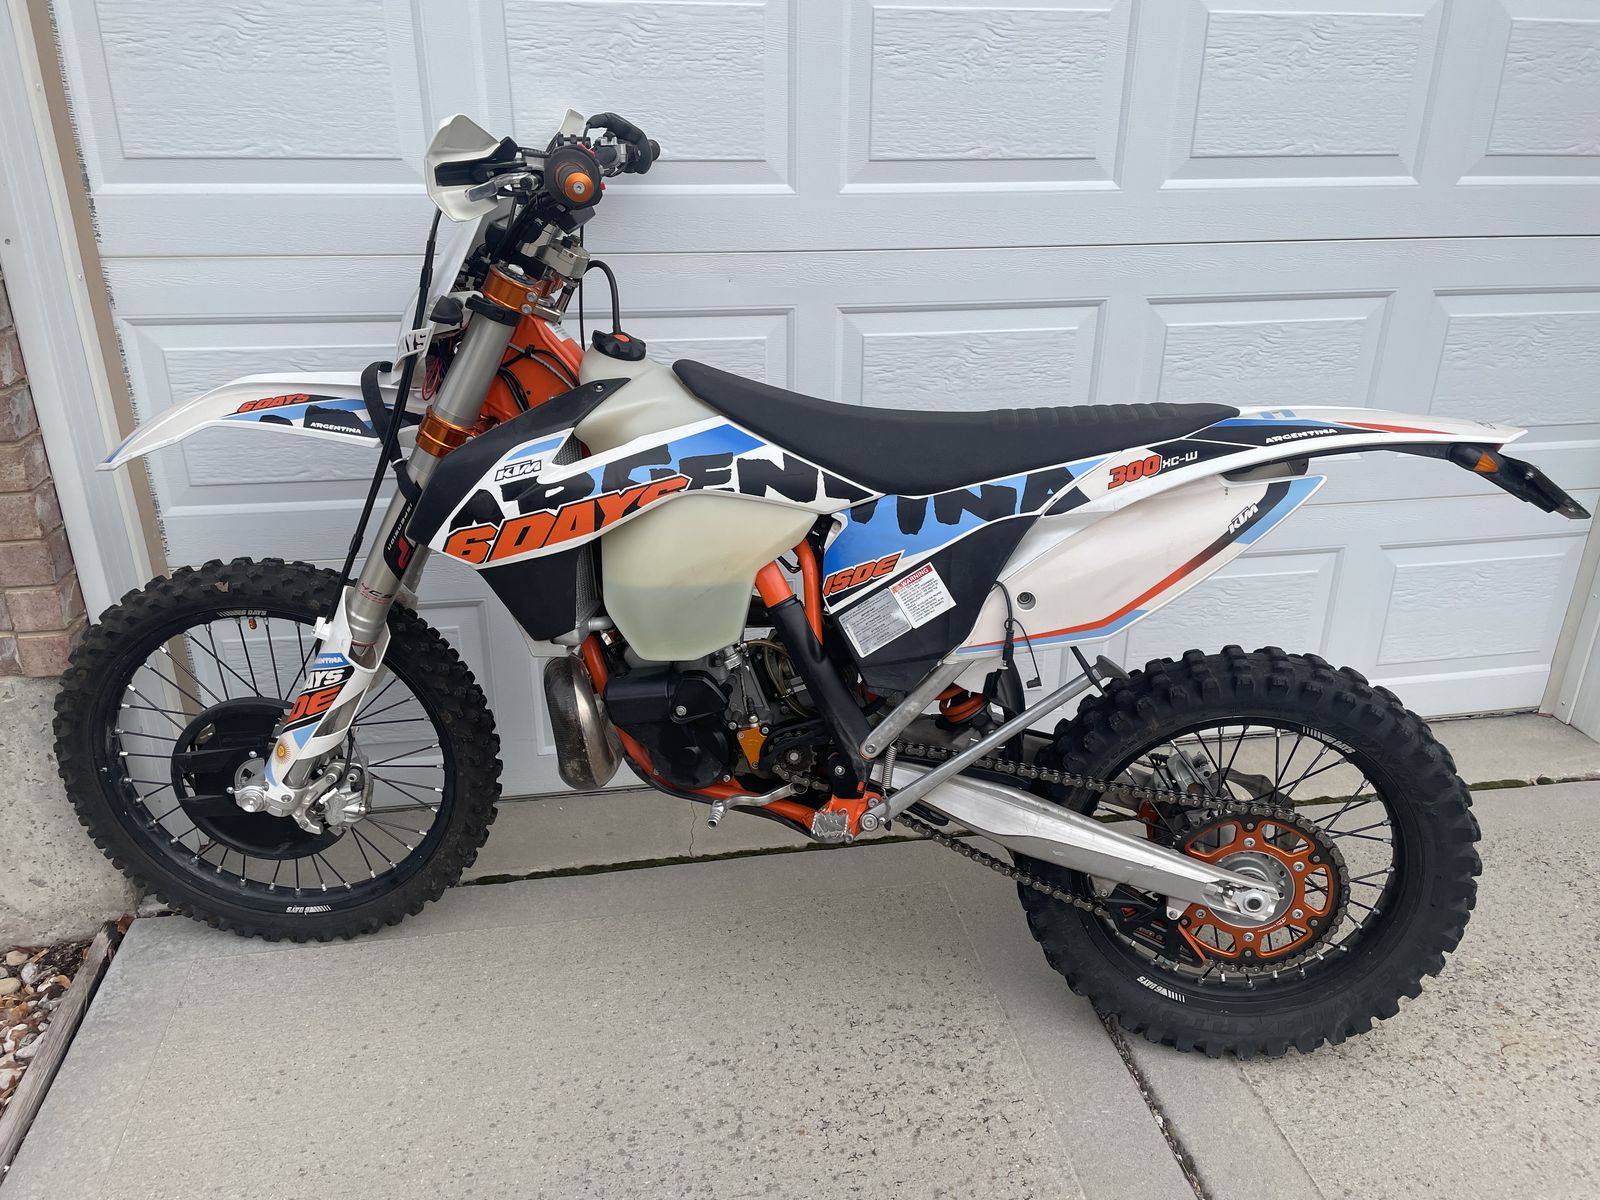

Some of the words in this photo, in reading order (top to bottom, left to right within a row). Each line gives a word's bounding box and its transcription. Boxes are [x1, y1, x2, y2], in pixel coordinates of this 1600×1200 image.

[309, 421, 362, 435] ARGENTINA
[1265, 427, 1339, 445] ARGENTINA
[494, 459, 543, 482] KTM
[1107, 454, 1162, 491] 300
[1162, 450, 1199, 470] XC-W
[1227, 502, 1260, 535] KTM
[822, 552, 902, 598] ISDE
[900, 566, 930, 589] WARNING
[1136, 975, 1158, 990] DAYS
